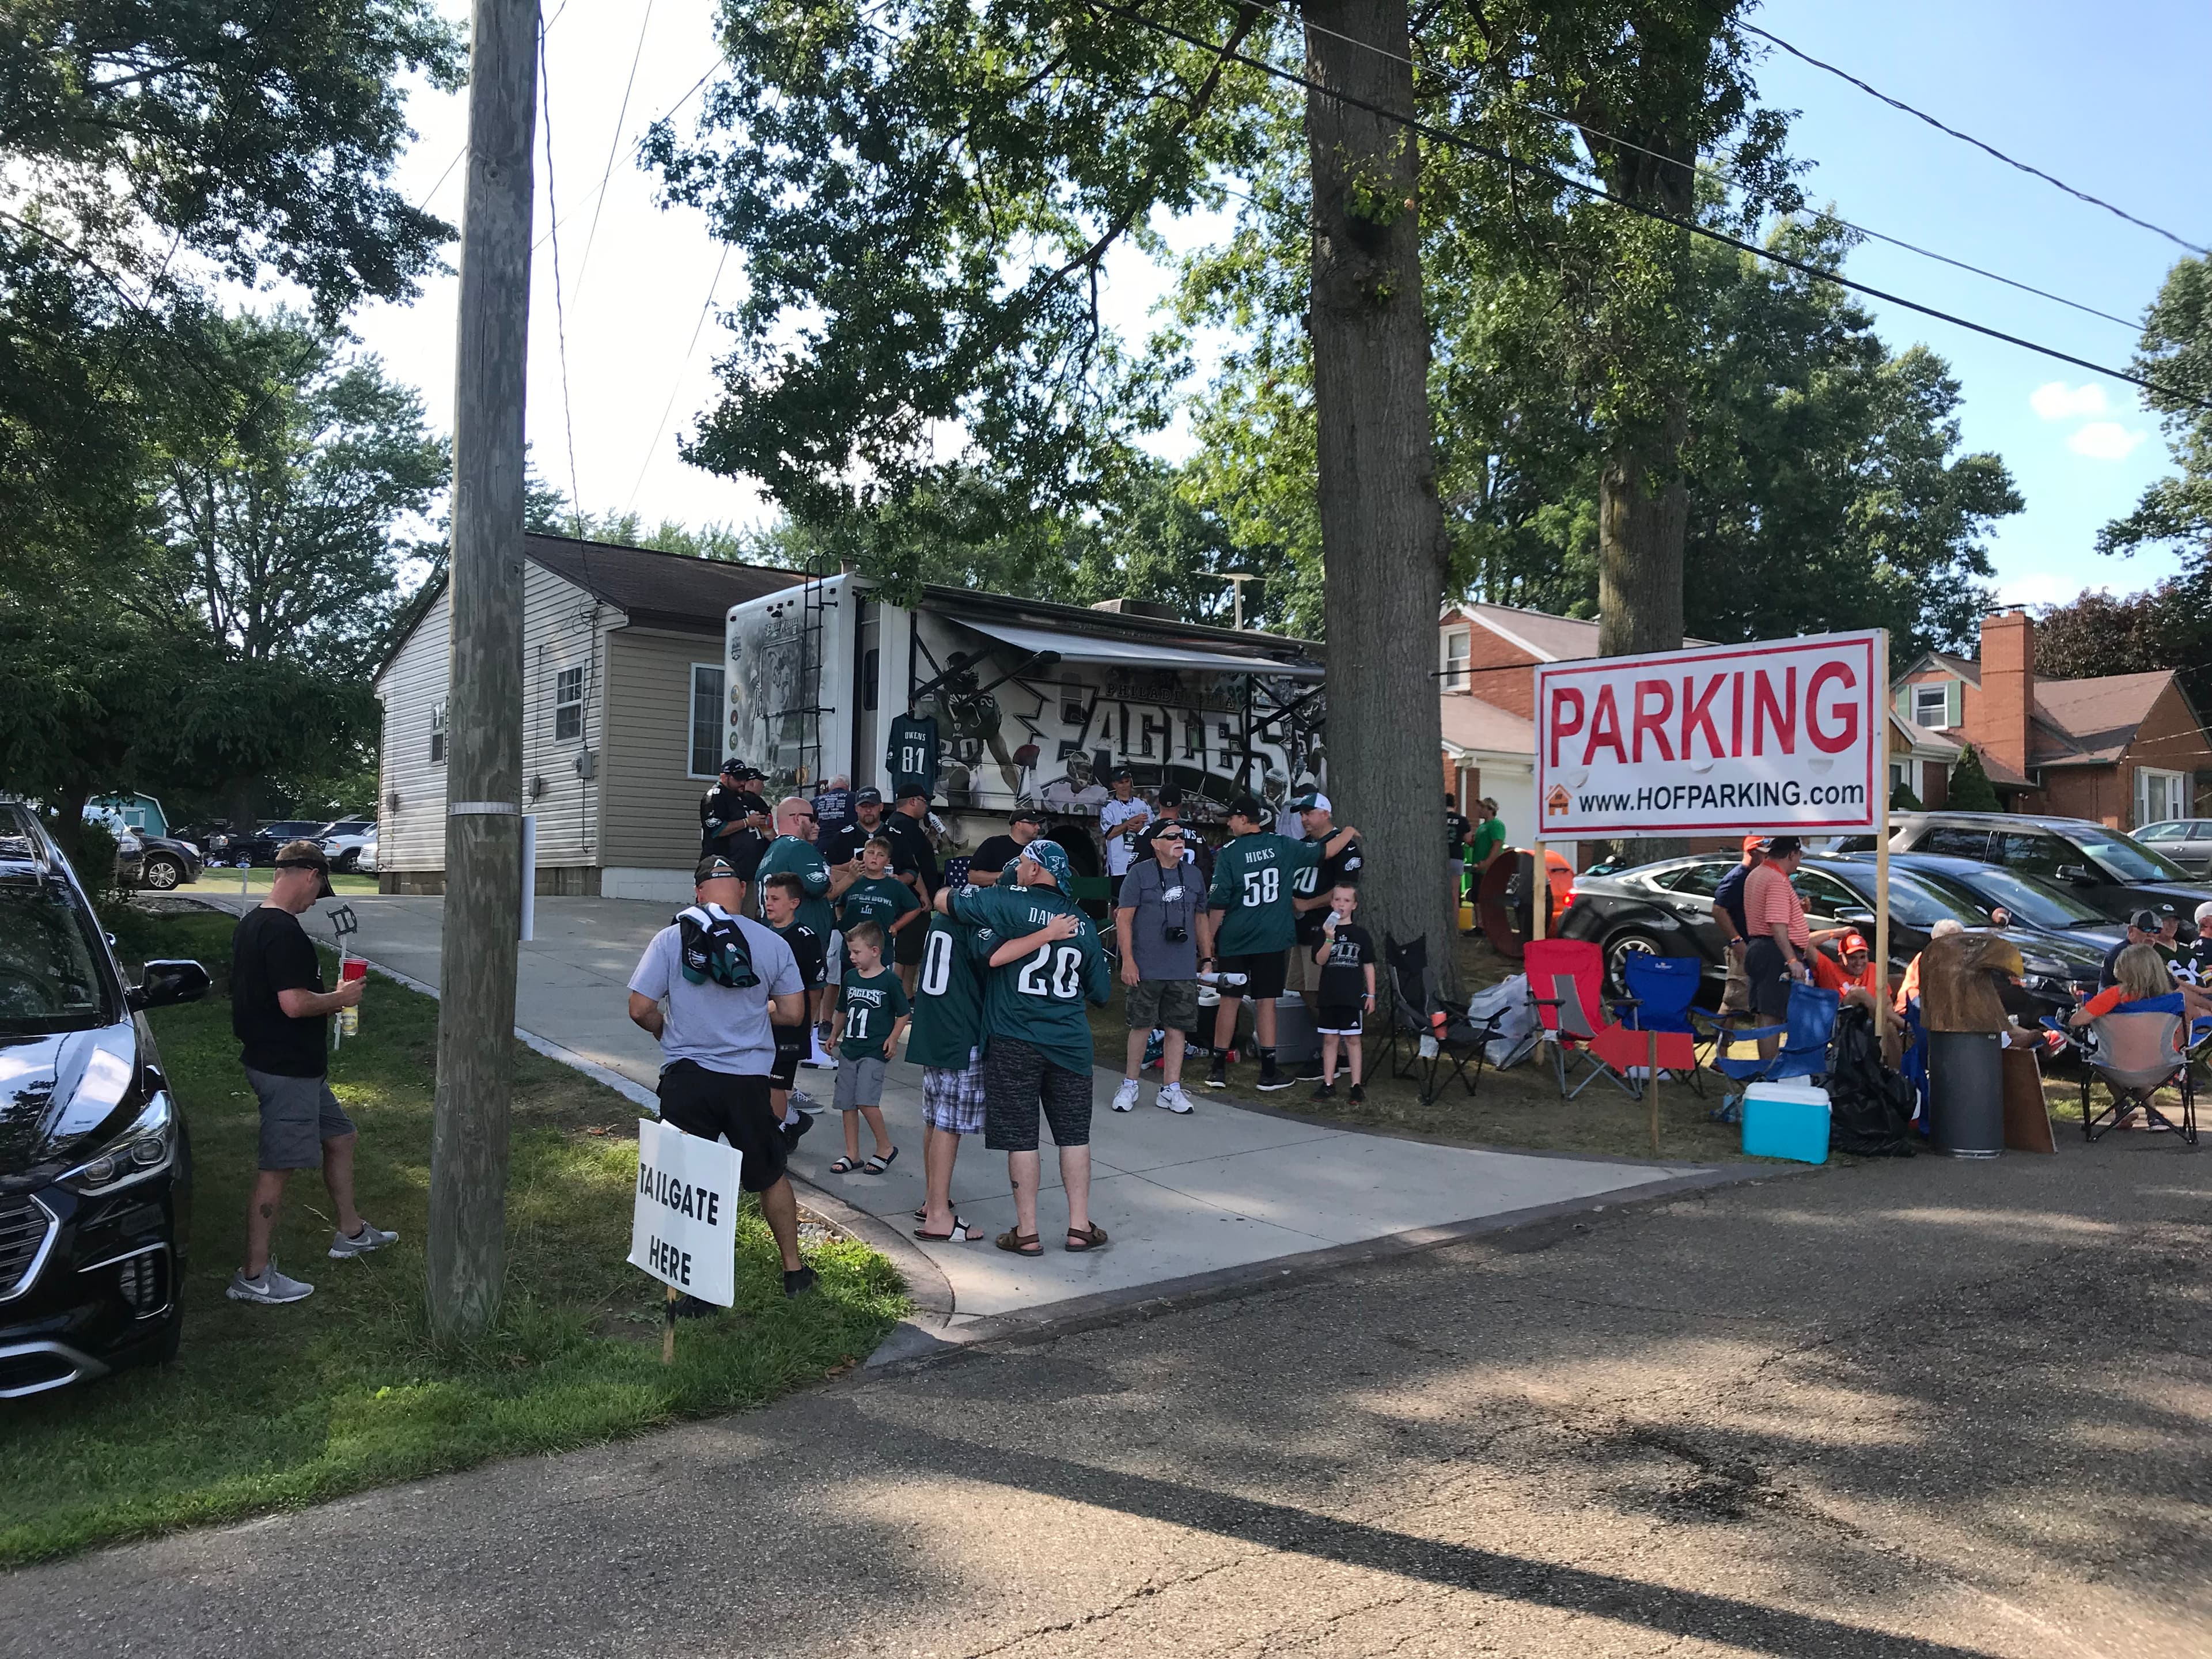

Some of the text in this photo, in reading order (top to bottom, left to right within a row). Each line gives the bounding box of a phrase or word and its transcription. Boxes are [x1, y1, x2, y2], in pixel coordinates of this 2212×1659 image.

[1551, 661, 1858, 767] PARKING
[904, 731, 926, 741] OWENS
[1012, 676, 1294, 812] EAGLES
[902, 746, 925, 774] 81
[1579, 781, 1864, 812] www.HOFPARKING.com
[1245, 848, 1275, 863] HICKS
[848, 893, 893, 907] SUPER BOWL
[1243, 868, 1279, 907] 58
[1018, 943, 1082, 998] 20
[847, 987, 881, 1006] EAGLES
[846, 1007, 869, 1039] 11
[639, 1162, 719, 1226] TAILGATE
[649, 1234, 692, 1286] HERE
